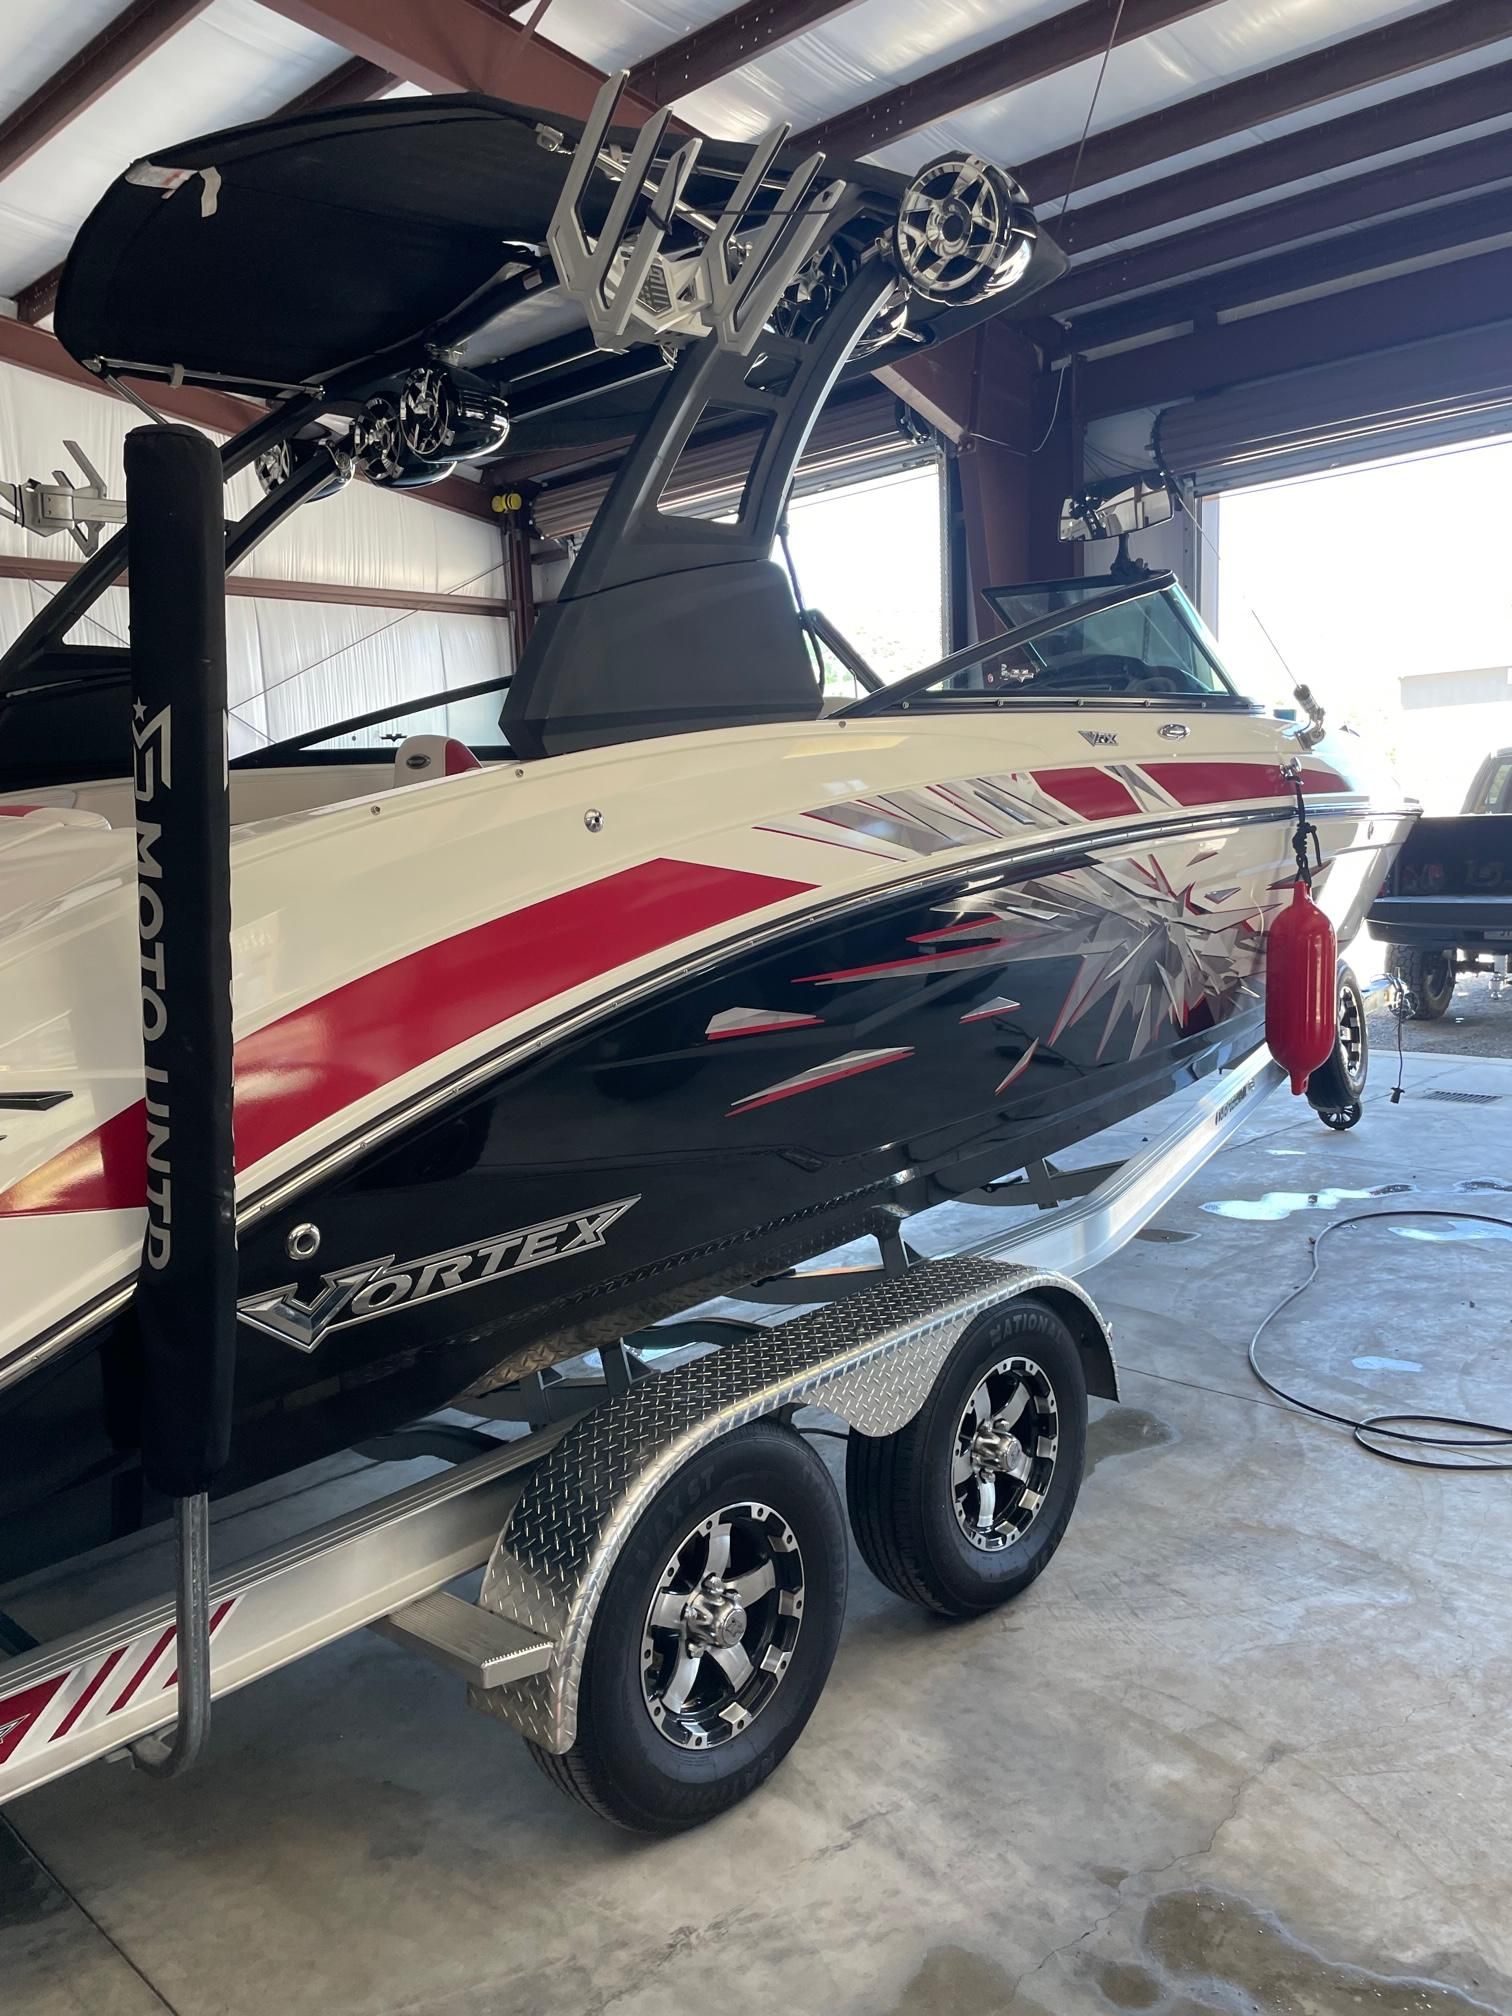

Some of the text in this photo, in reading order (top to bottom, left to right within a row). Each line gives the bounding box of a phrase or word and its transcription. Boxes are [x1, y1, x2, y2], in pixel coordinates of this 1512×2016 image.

[136, 819, 171, 1270] MOTO UNTD
[237, 1194, 641, 1352] VORTEX
